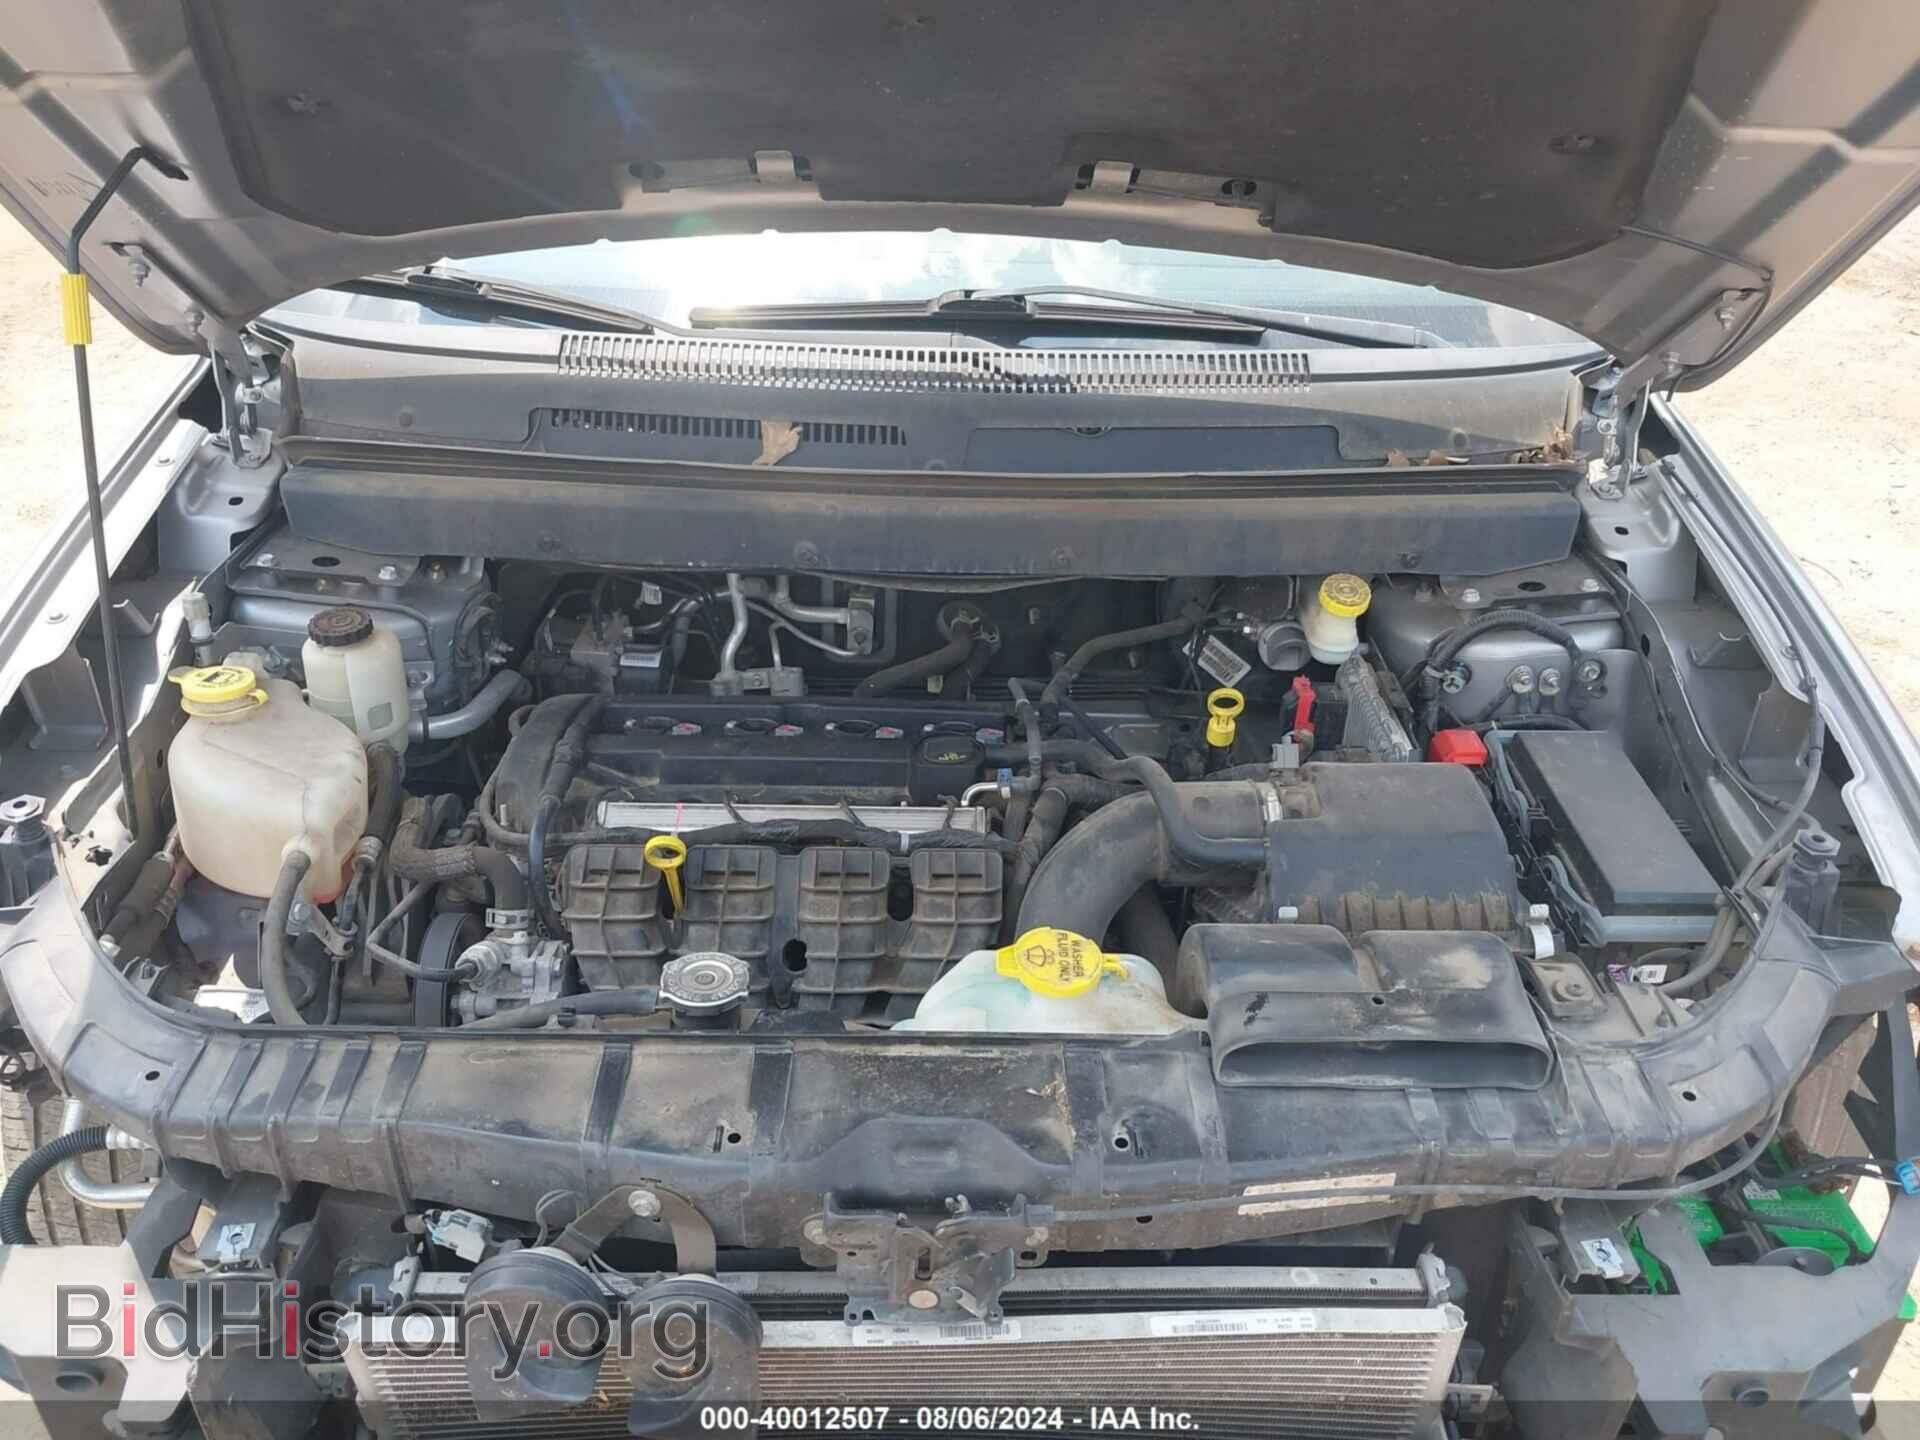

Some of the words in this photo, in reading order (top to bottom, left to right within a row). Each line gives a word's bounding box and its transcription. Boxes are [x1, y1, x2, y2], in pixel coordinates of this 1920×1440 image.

[1056, 932, 1069, 957] FLUID
[1059, 960, 1071, 982] ONLY
[1071, 940, 1085, 978] WASHER
